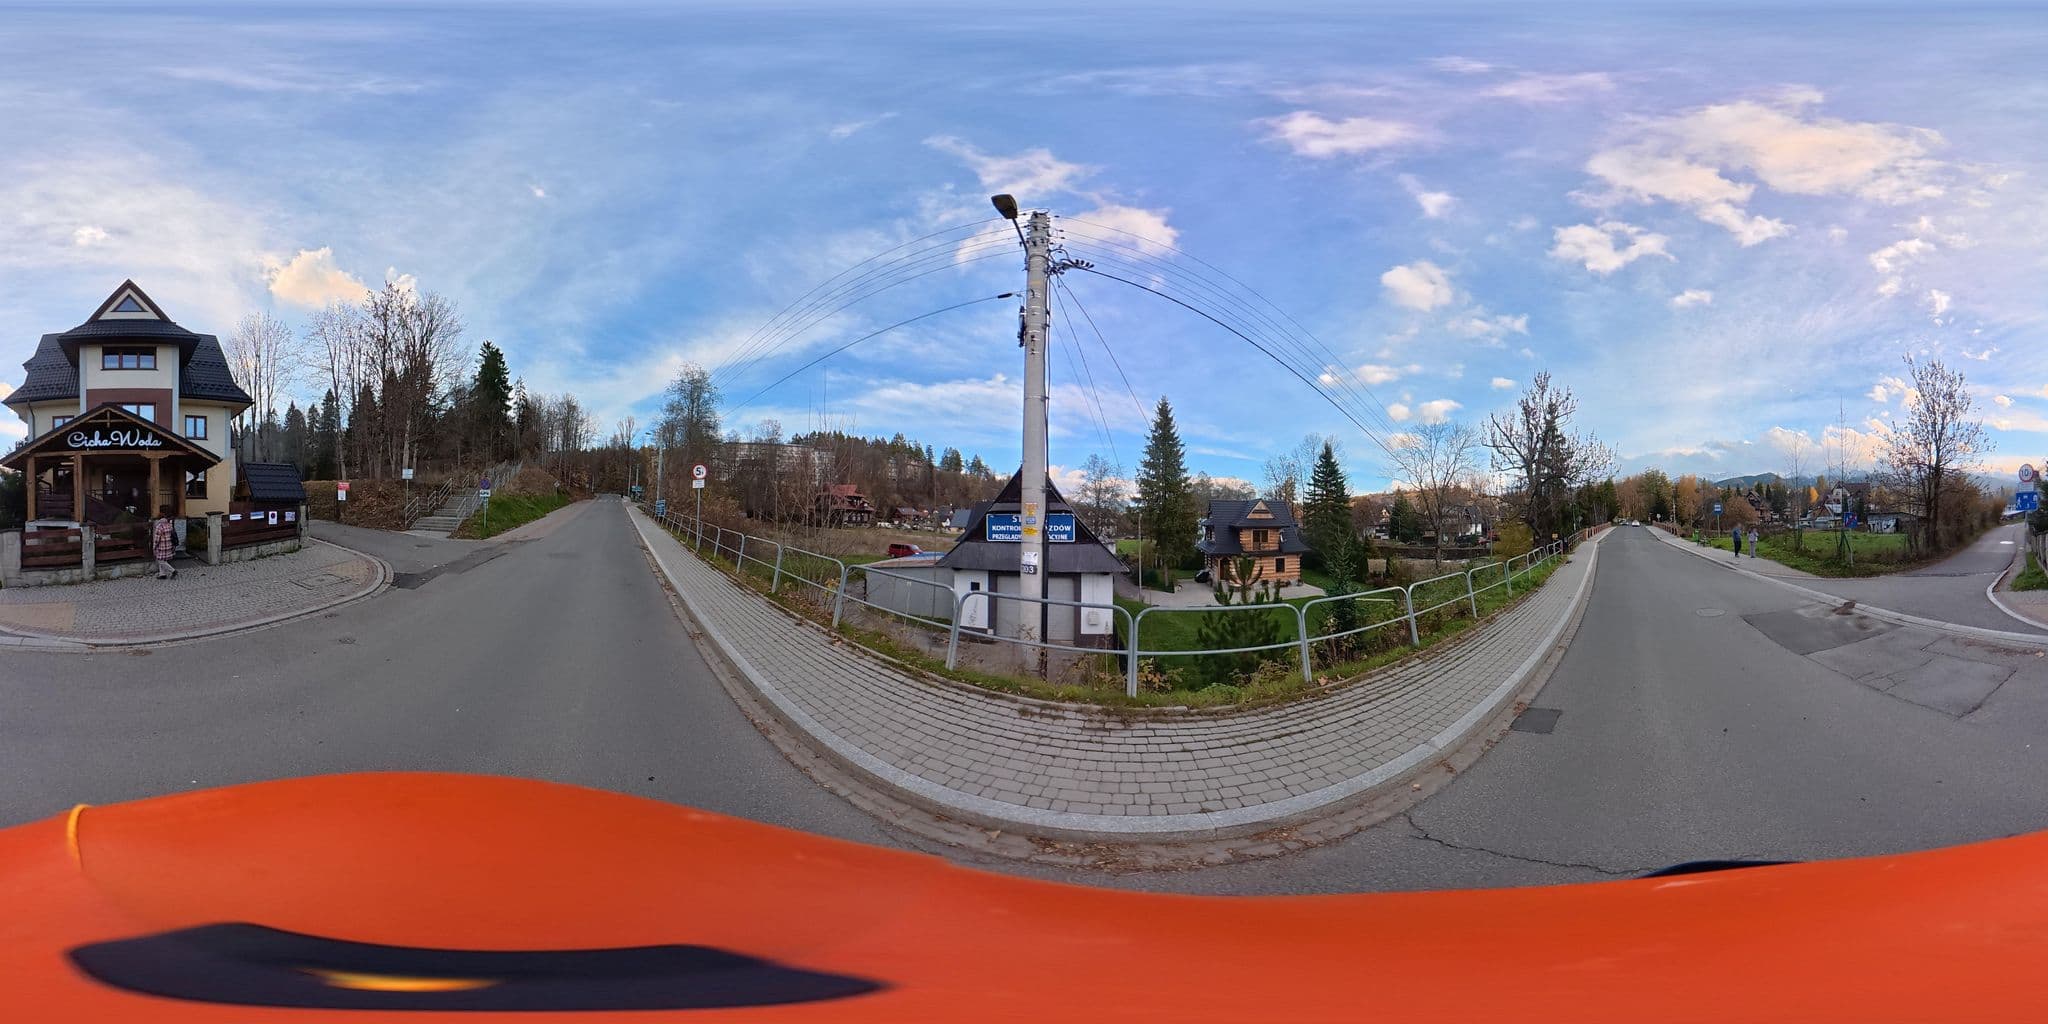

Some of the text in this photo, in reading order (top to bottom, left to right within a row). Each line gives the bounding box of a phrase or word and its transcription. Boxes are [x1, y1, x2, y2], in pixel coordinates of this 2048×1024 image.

[67, 428, 162, 448] Cicha Woda
[1048, 524, 1072, 532] ZDÓW
